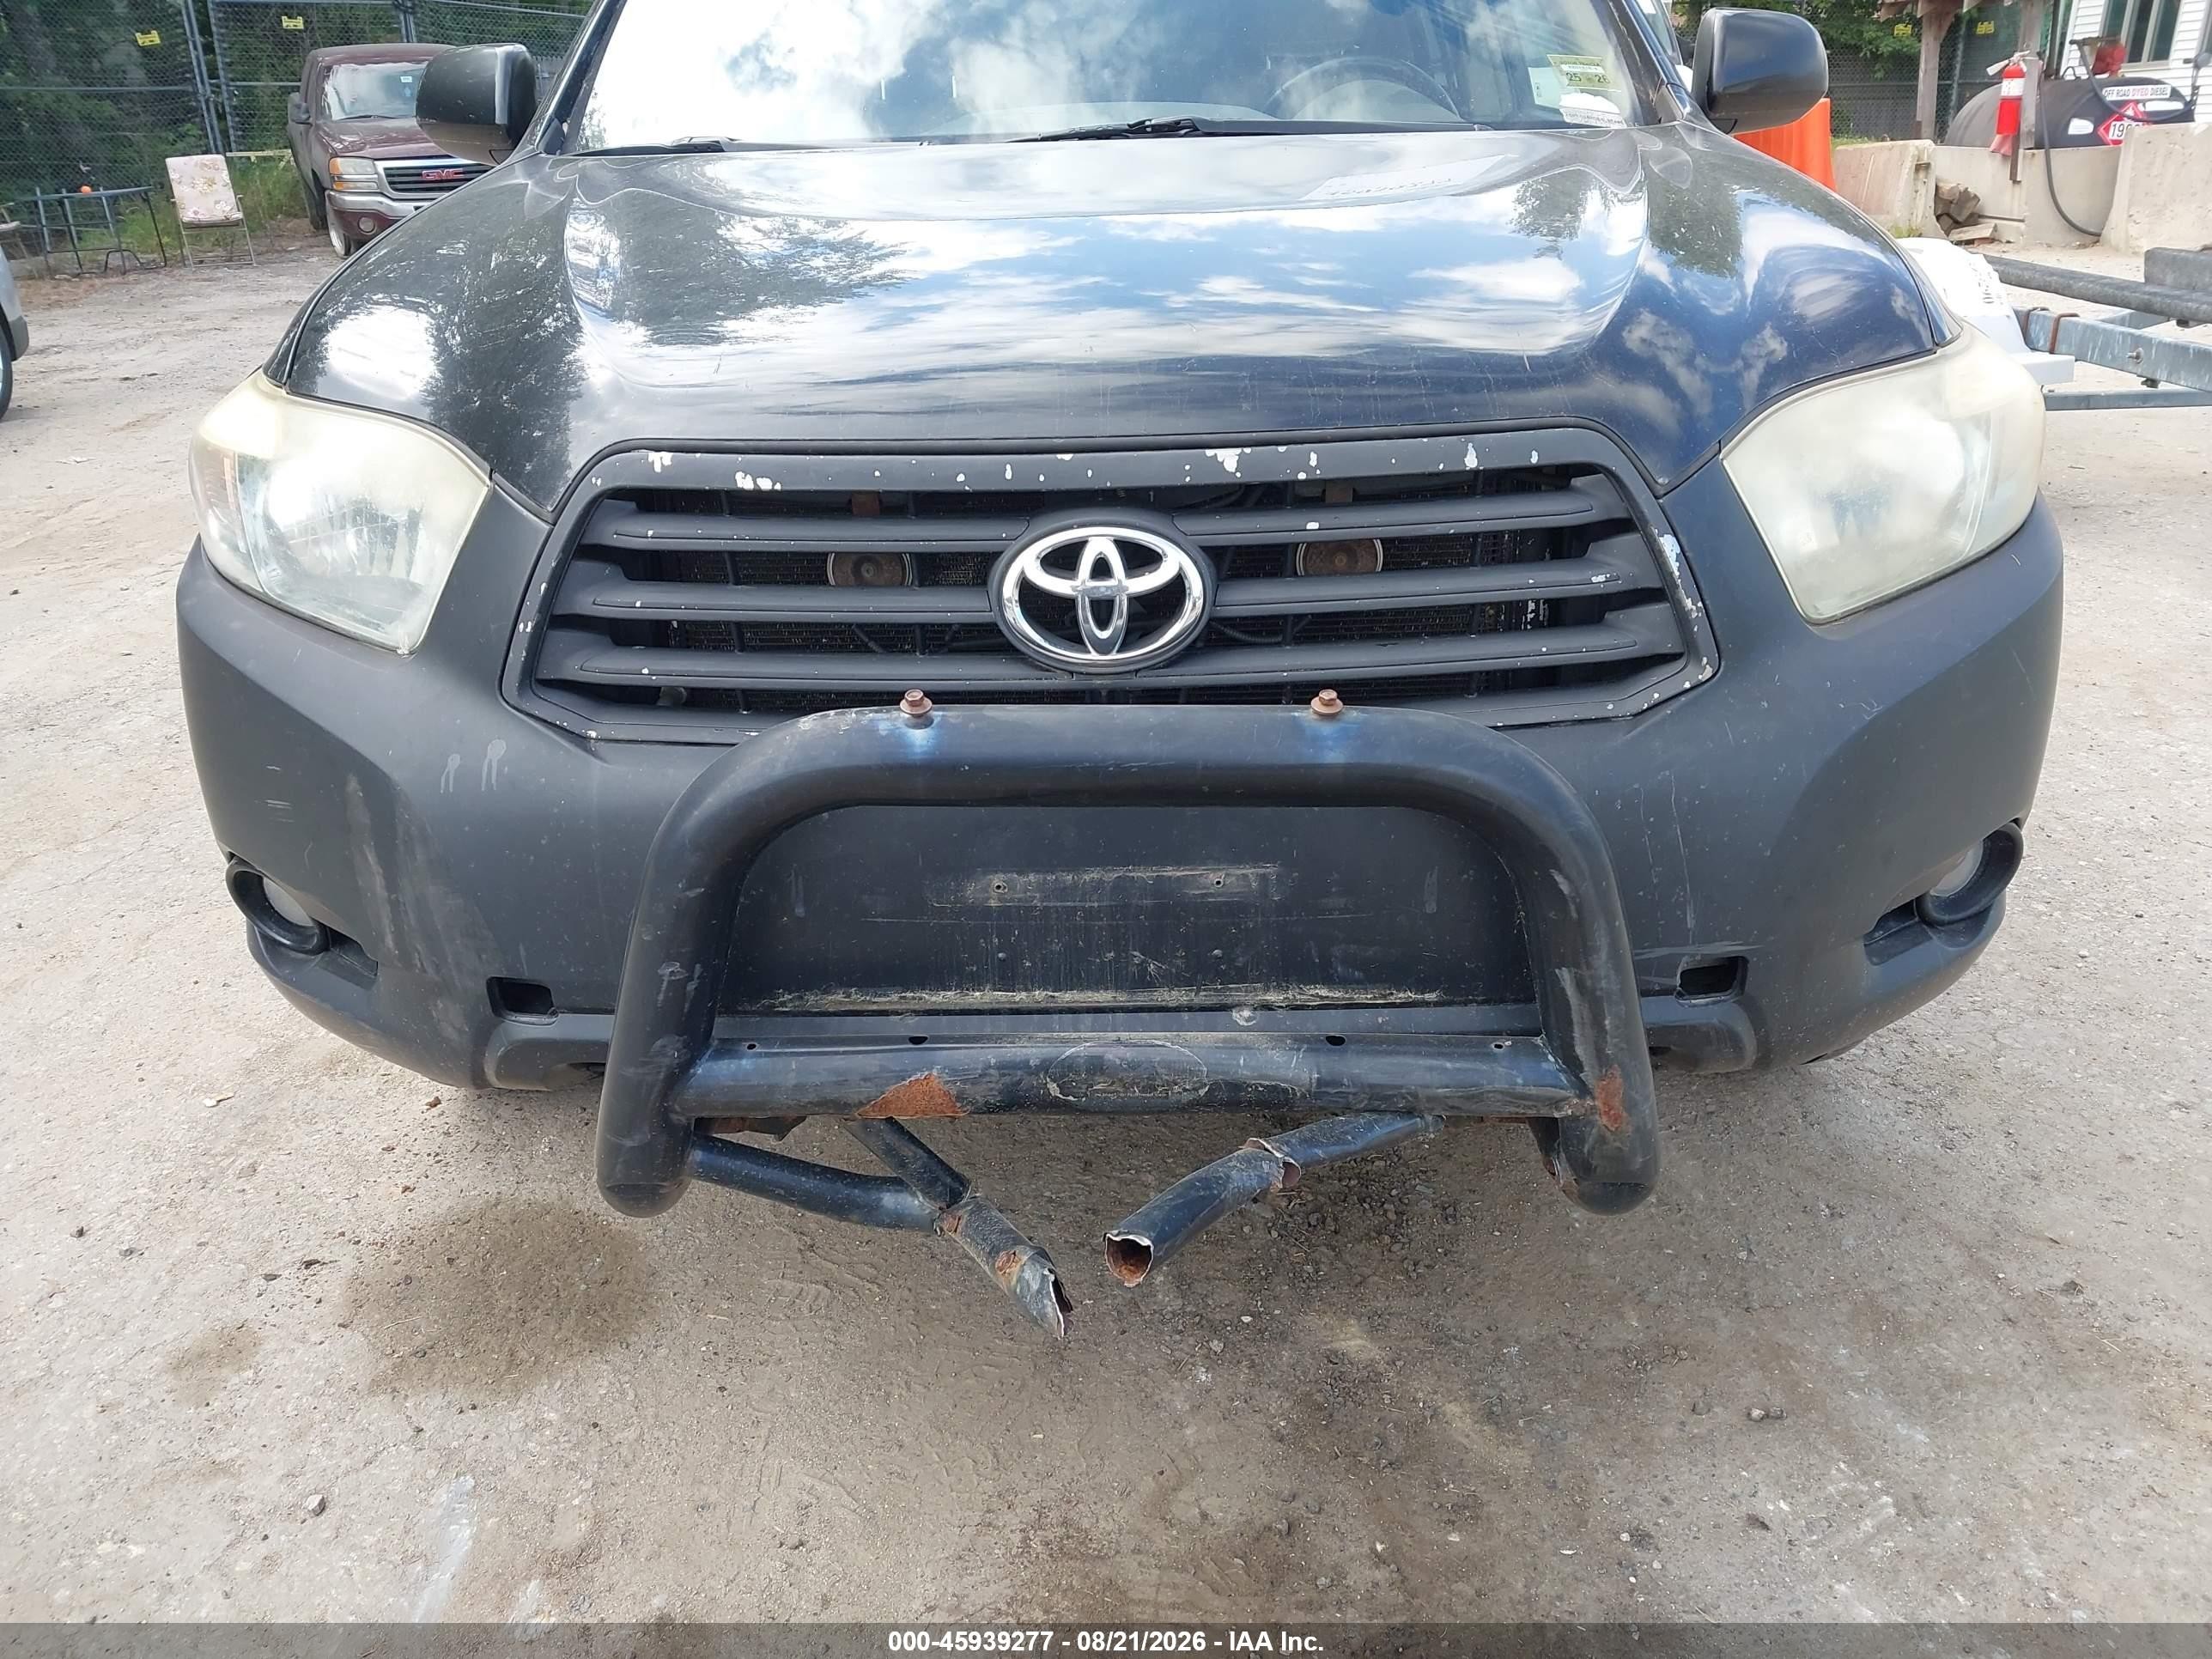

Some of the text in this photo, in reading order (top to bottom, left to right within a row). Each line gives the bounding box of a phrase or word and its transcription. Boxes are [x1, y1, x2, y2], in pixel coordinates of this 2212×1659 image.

[1566, 72, 1582, 82] 25
[2104, 87, 2169, 98] OFF ROAD DYED DIESEL
[421, 168, 464, 179] GMC
